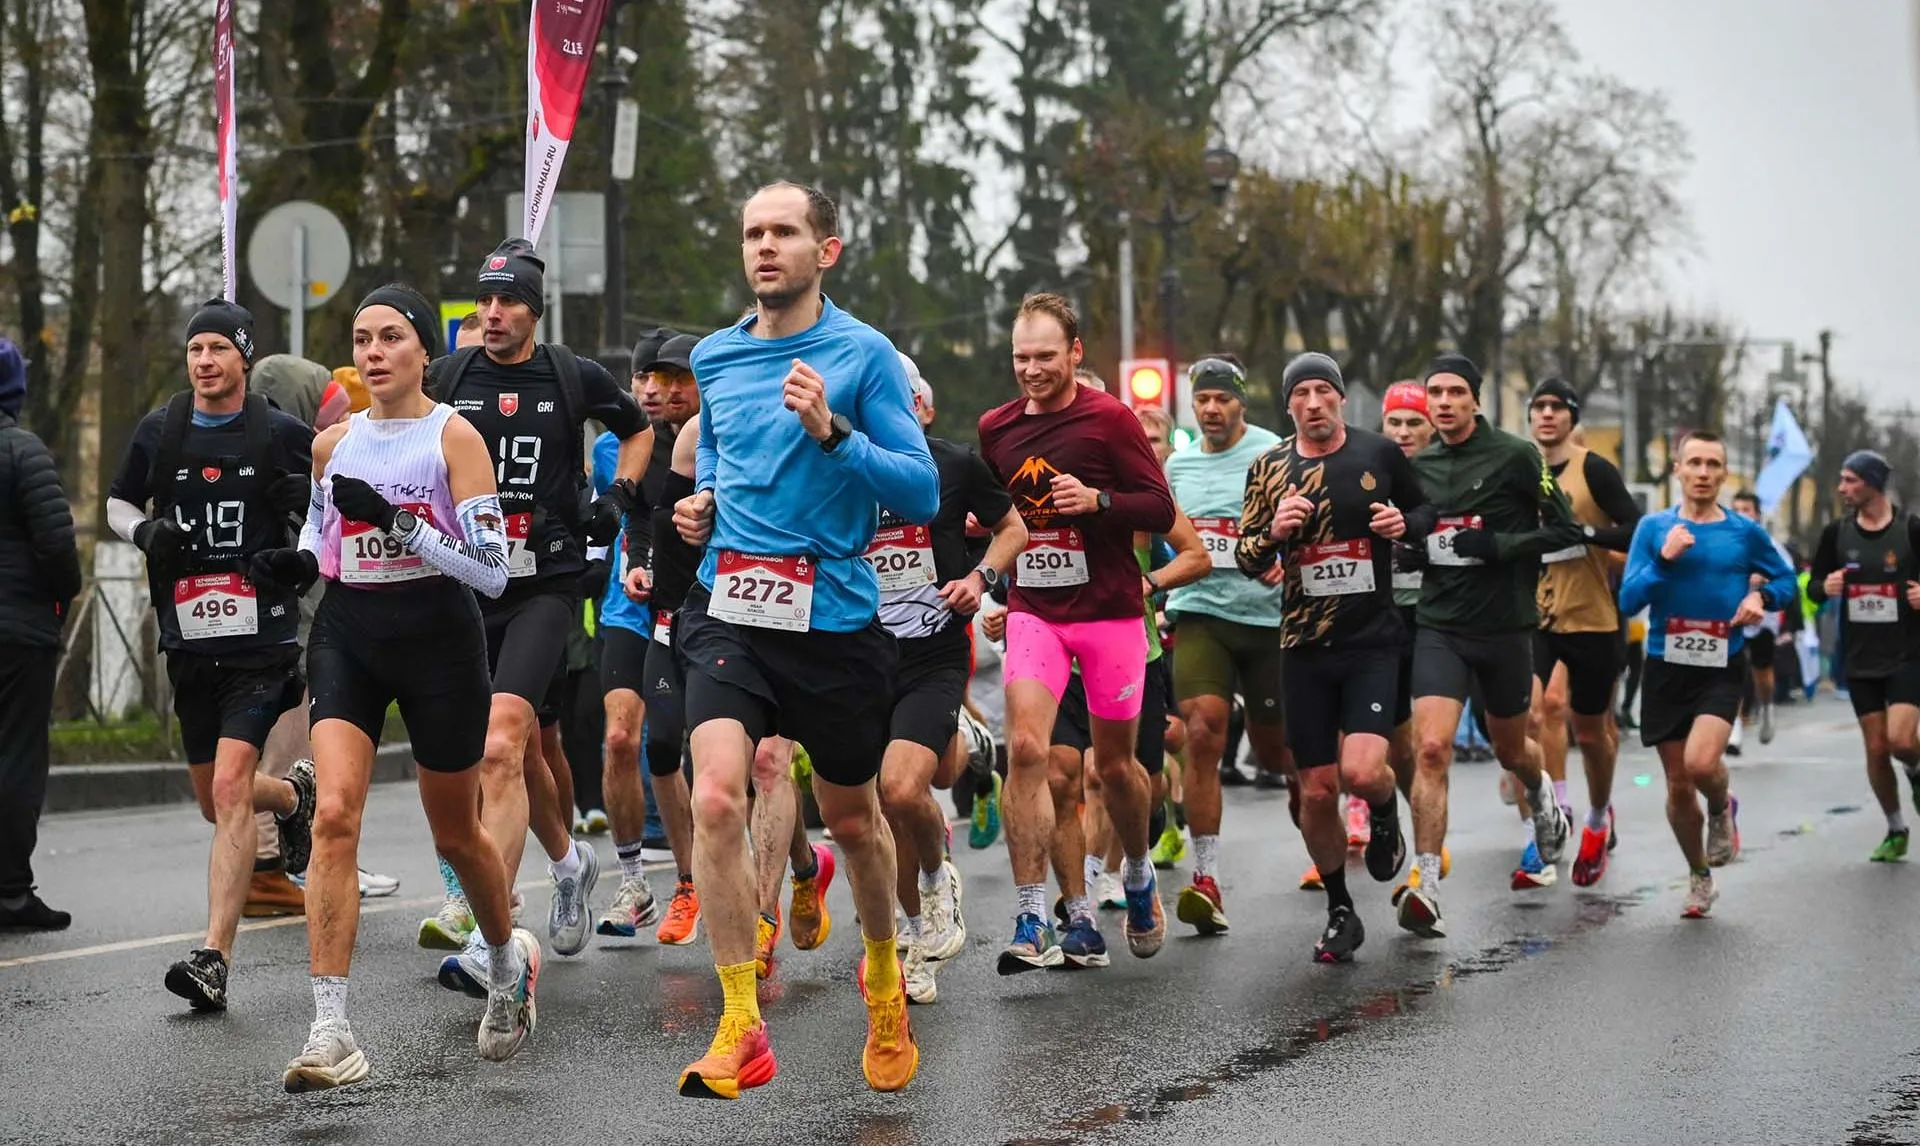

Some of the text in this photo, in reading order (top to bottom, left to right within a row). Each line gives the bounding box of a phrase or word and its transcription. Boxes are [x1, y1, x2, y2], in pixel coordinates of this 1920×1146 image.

[537, 401, 554, 413] GRi
[1020, 508, 1059, 517] UJITRA
[356, 536, 417, 559] 109
[1200, 538, 1228, 552] 38
[1025, 552, 1074, 570] 2501
[1313, 561, 1358, 581] 2117
[727, 575, 795, 606] 2272
[191, 599, 239, 620] 496
[270, 604, 285, 617] GRi
[1674, 636, 1718, 652] 2225
